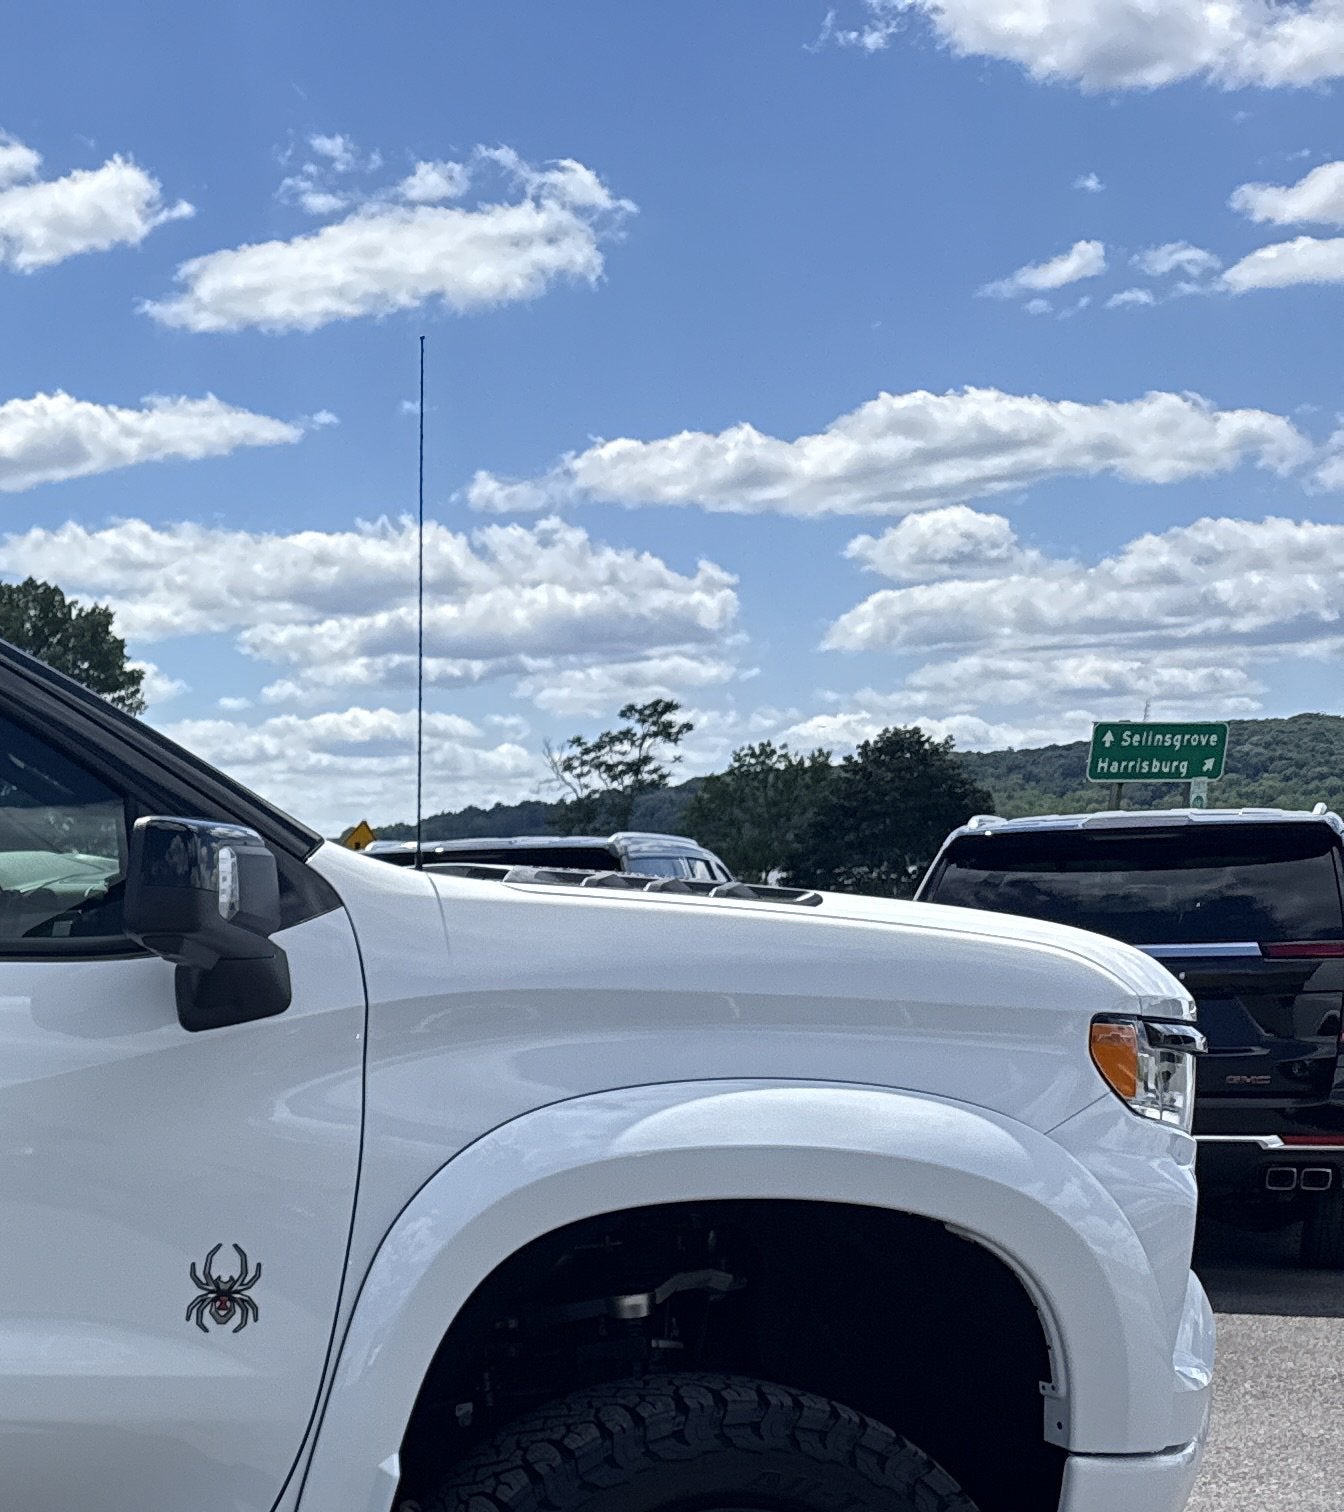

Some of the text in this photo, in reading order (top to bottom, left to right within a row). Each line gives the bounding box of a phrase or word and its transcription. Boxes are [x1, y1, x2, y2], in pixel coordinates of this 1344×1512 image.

[1120, 730, 1218, 750] Selinsgrove
[1096, 757, 1188, 777] Harrisburg
[1226, 1075, 1271, 1084] GMC
